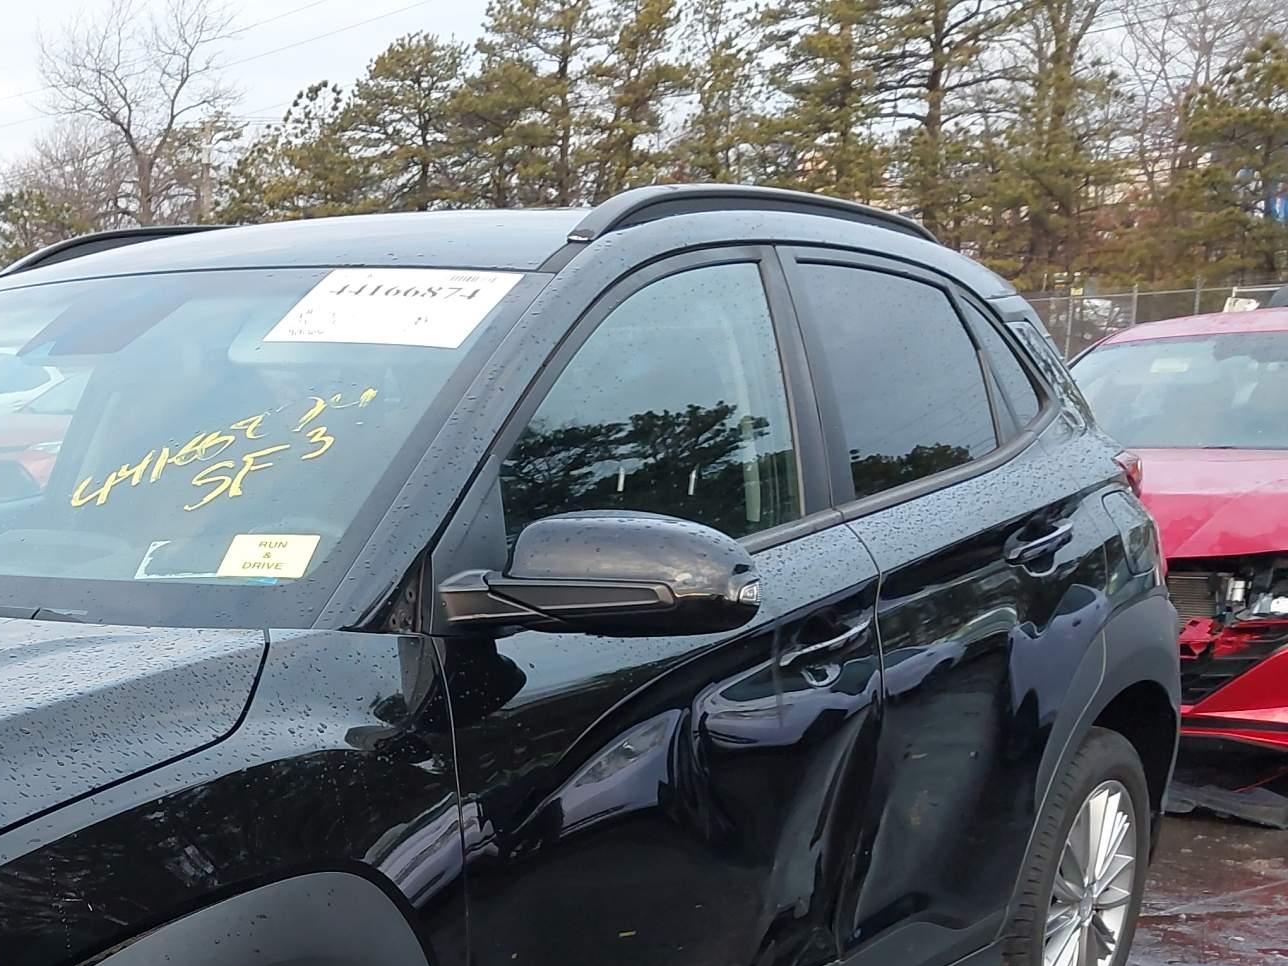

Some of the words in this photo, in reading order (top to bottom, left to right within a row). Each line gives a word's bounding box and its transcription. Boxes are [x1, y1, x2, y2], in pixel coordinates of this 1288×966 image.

[329, 283, 481, 300] 44166874
[258, 540, 289, 549] RUN
[262, 551, 272, 559] &
[241, 561, 285, 570] DRIVE
